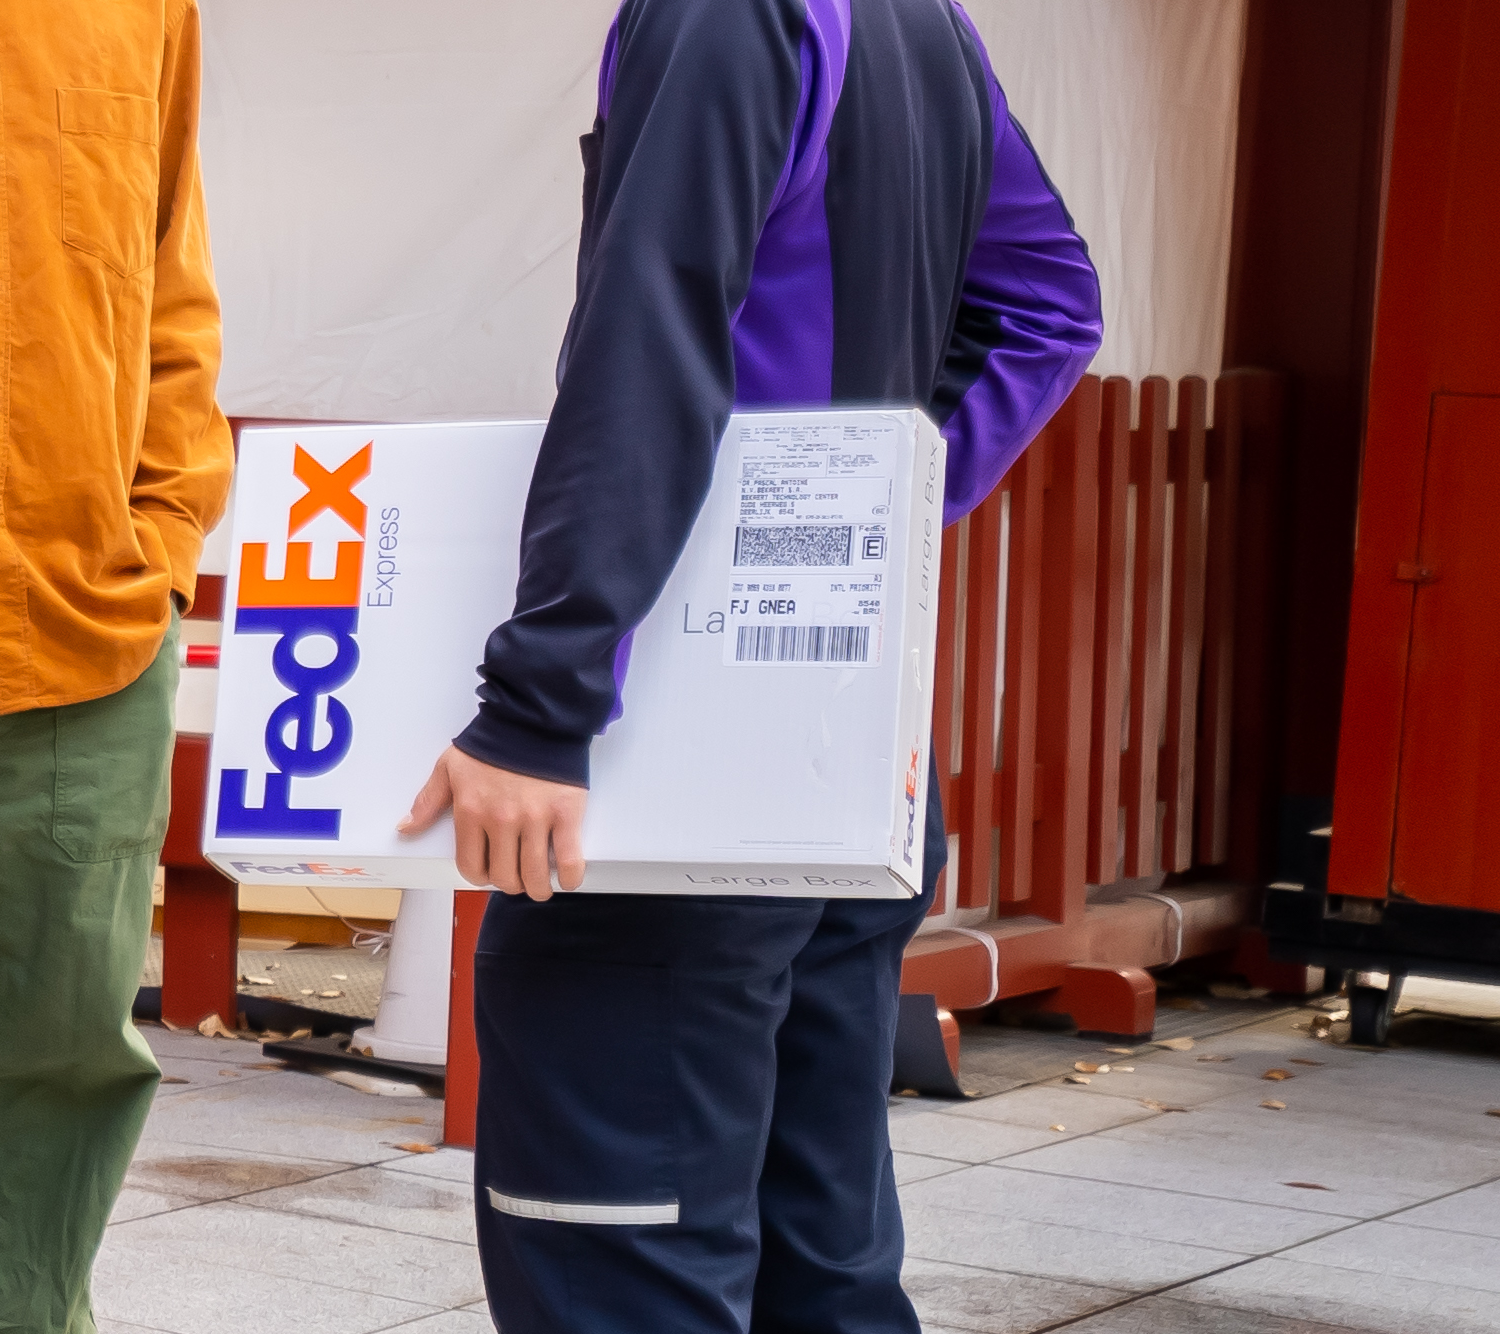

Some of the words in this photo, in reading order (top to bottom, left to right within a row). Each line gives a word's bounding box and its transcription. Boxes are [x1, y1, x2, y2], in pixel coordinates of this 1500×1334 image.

[925, 442, 938, 505] Box
[814, 493, 839, 501] CENTER
[366, 506, 401, 608] Express
[866, 539, 881, 557] E
[919, 518, 933, 612] Large
[849, 584, 882, 592] PRIORITY
[730, 599, 750, 615] FJ
[758, 599, 796, 615] GNEA
[215, 439, 374, 841] FedEx
[903, 747, 919, 869] FedEx
[229, 861, 371, 876] FedEx
[686, 873, 790, 888] Large
[802, 875, 877, 888] Box
